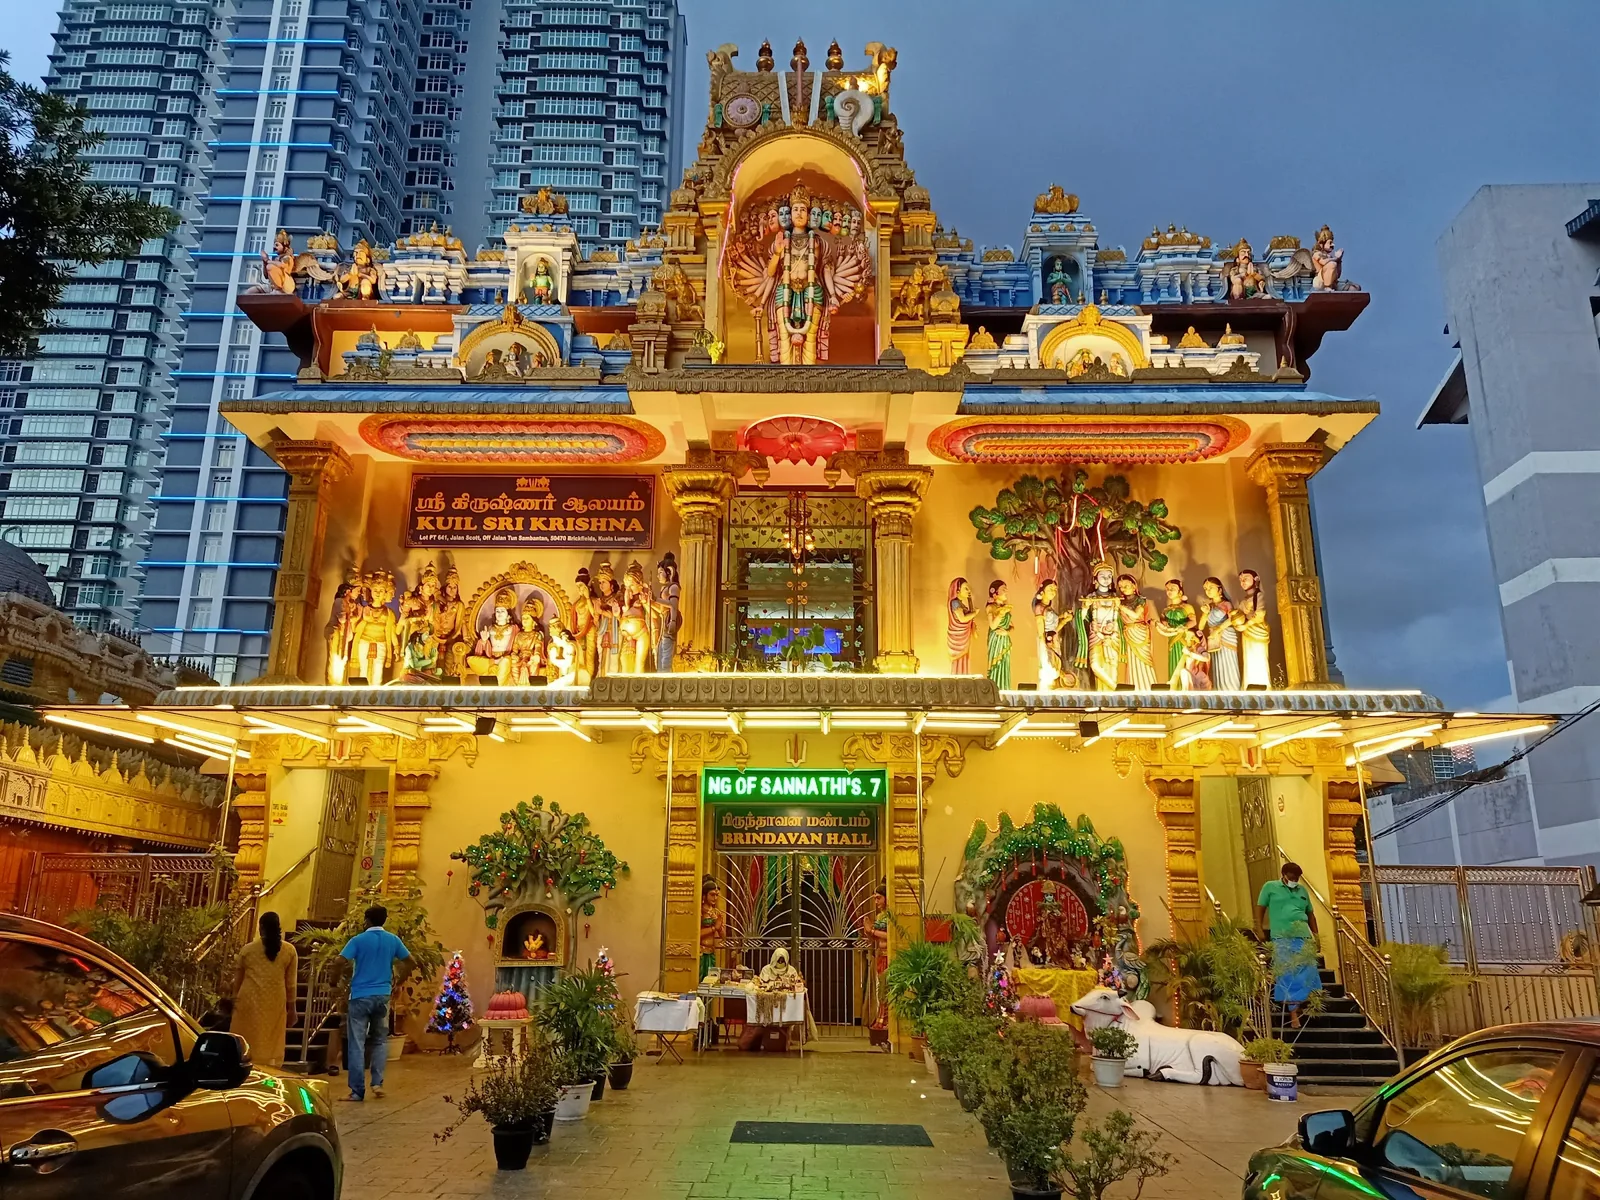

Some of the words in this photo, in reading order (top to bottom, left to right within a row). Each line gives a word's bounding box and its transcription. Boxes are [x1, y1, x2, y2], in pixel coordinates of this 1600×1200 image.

[451, 492, 557, 514] கிருஷ்ணர்
[562, 491, 645, 513] ஆலயம்
[416, 517, 478, 531] KUIL
[482, 517, 524, 531] SRI
[529, 517, 645, 532] KRISHNA
[507, 534, 518, 542] Tun
[708, 776, 732, 795] NG
[735, 777, 757, 795] OF
[870, 778, 881, 797] 7
[806, 810, 871, 828] மண்டபம்
[721, 832, 823, 845] BRINDAVAN
[826, 833, 872, 845] HALL
